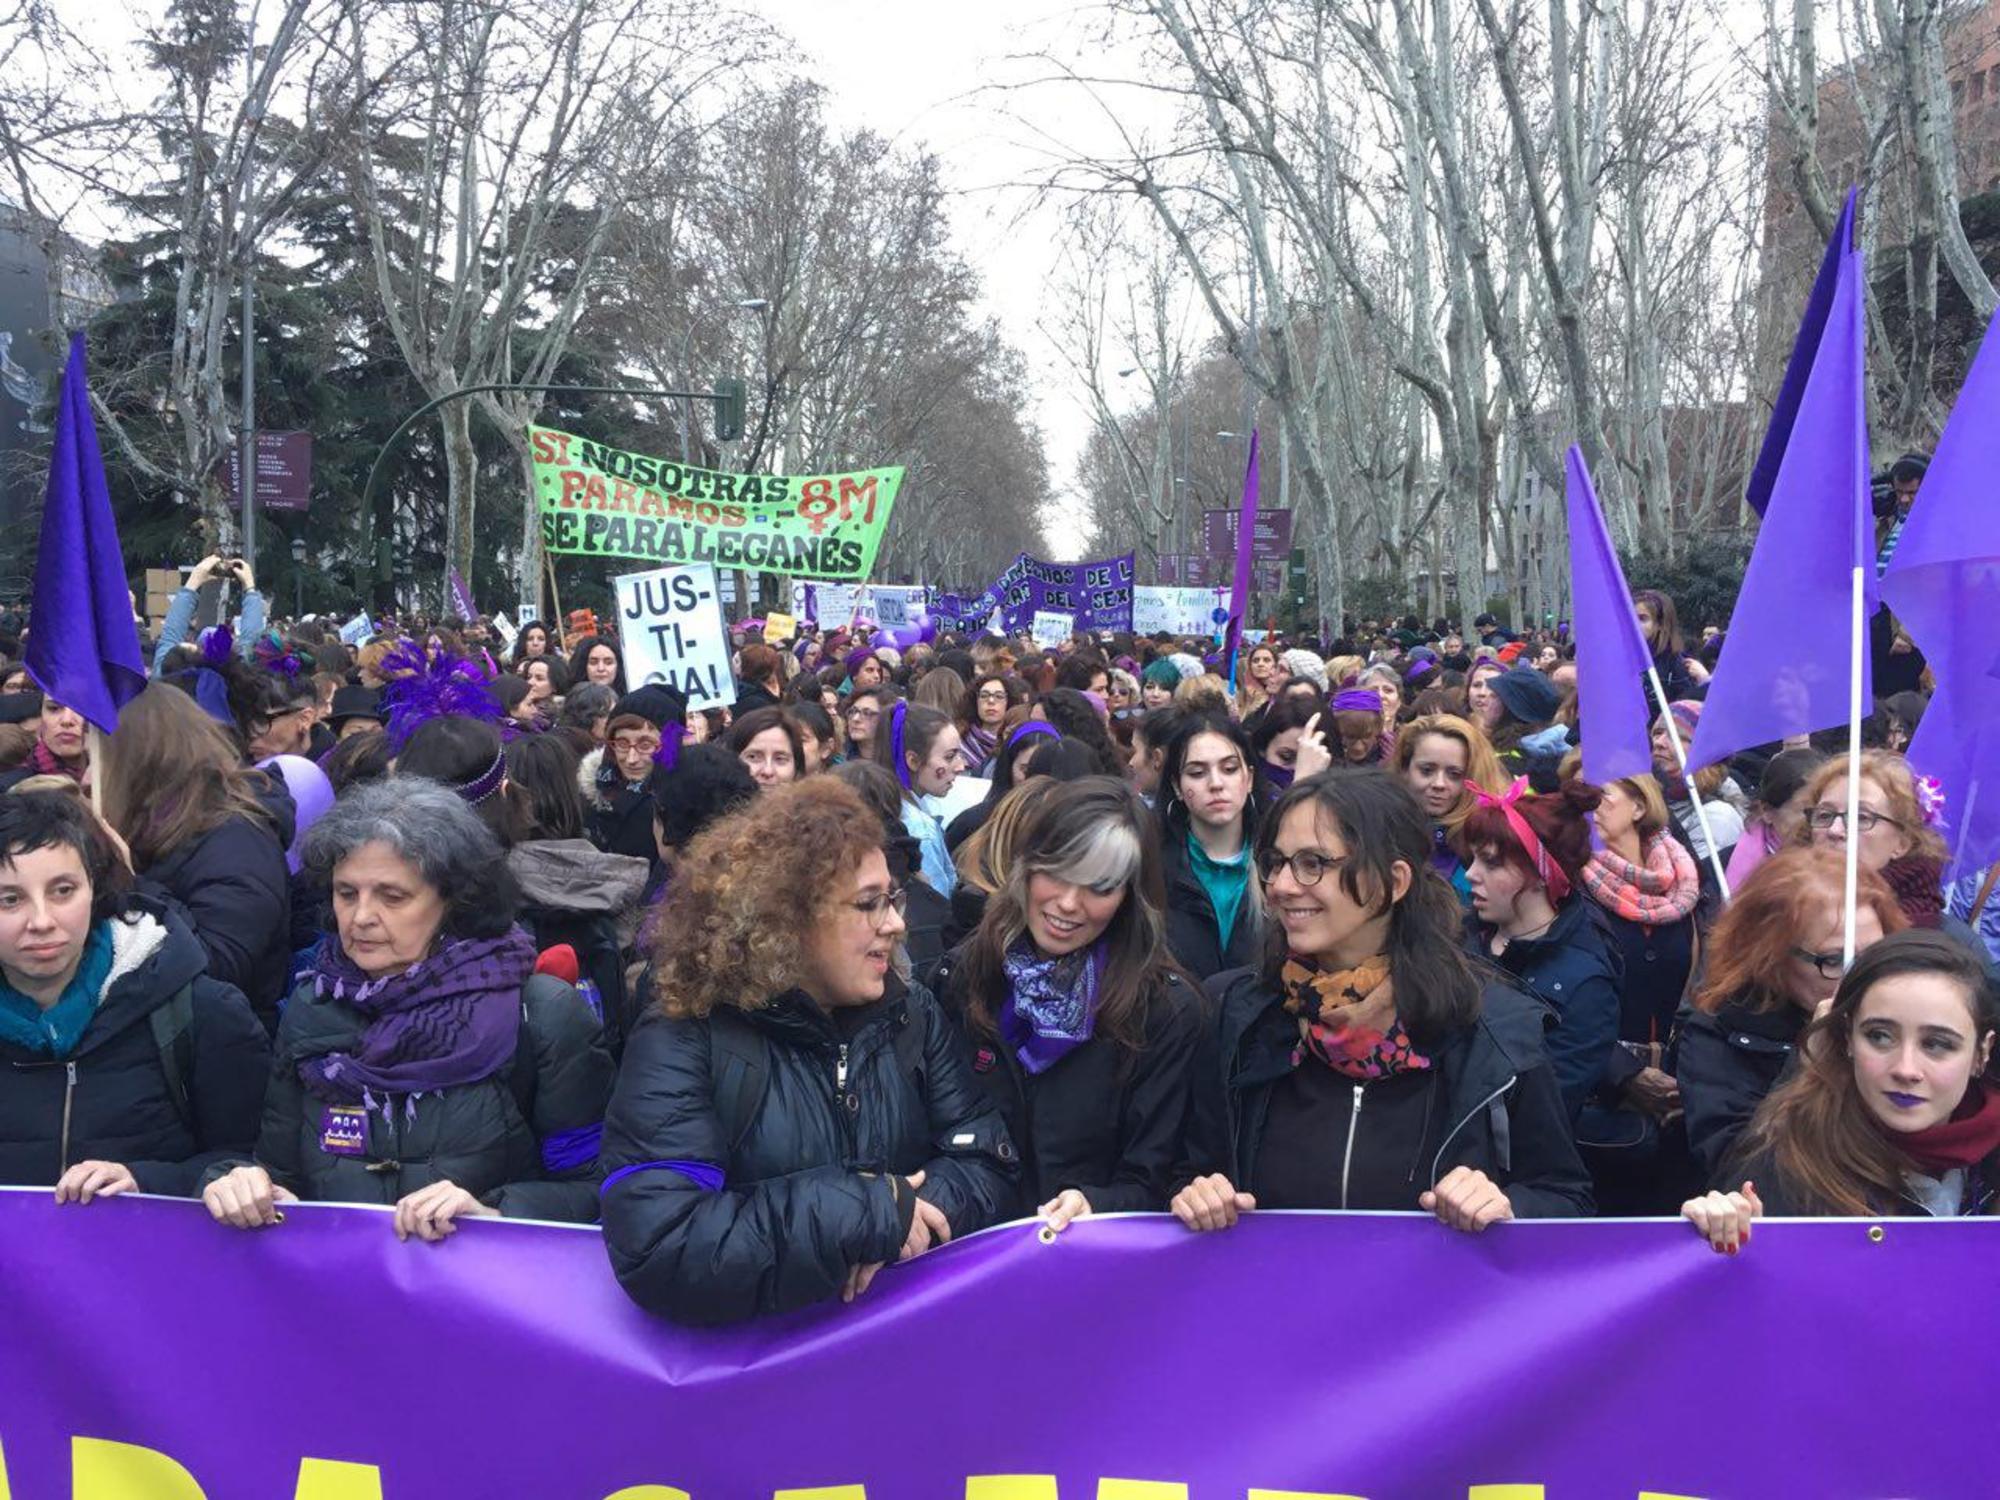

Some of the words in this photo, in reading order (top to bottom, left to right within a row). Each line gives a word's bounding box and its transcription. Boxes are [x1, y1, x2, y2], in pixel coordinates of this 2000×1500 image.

[532, 431, 571, 467] SI
[581, 440, 791, 503] NOSOTRAS
[559, 471, 748, 528] PARAMOS
[797, 475, 878, 534] 8M
[542, 511, 579, 550] SE
[583, 513, 687, 561] PARA
[691, 525, 863, 574] LEGANÉS
[625, 574, 712, 620] JUS-
[1046, 591, 1077, 610] DEL
[1092, 586, 1132, 610] SEX
[1086, 567, 1111, 588] DE
[648, 622, 697, 661] TI-
